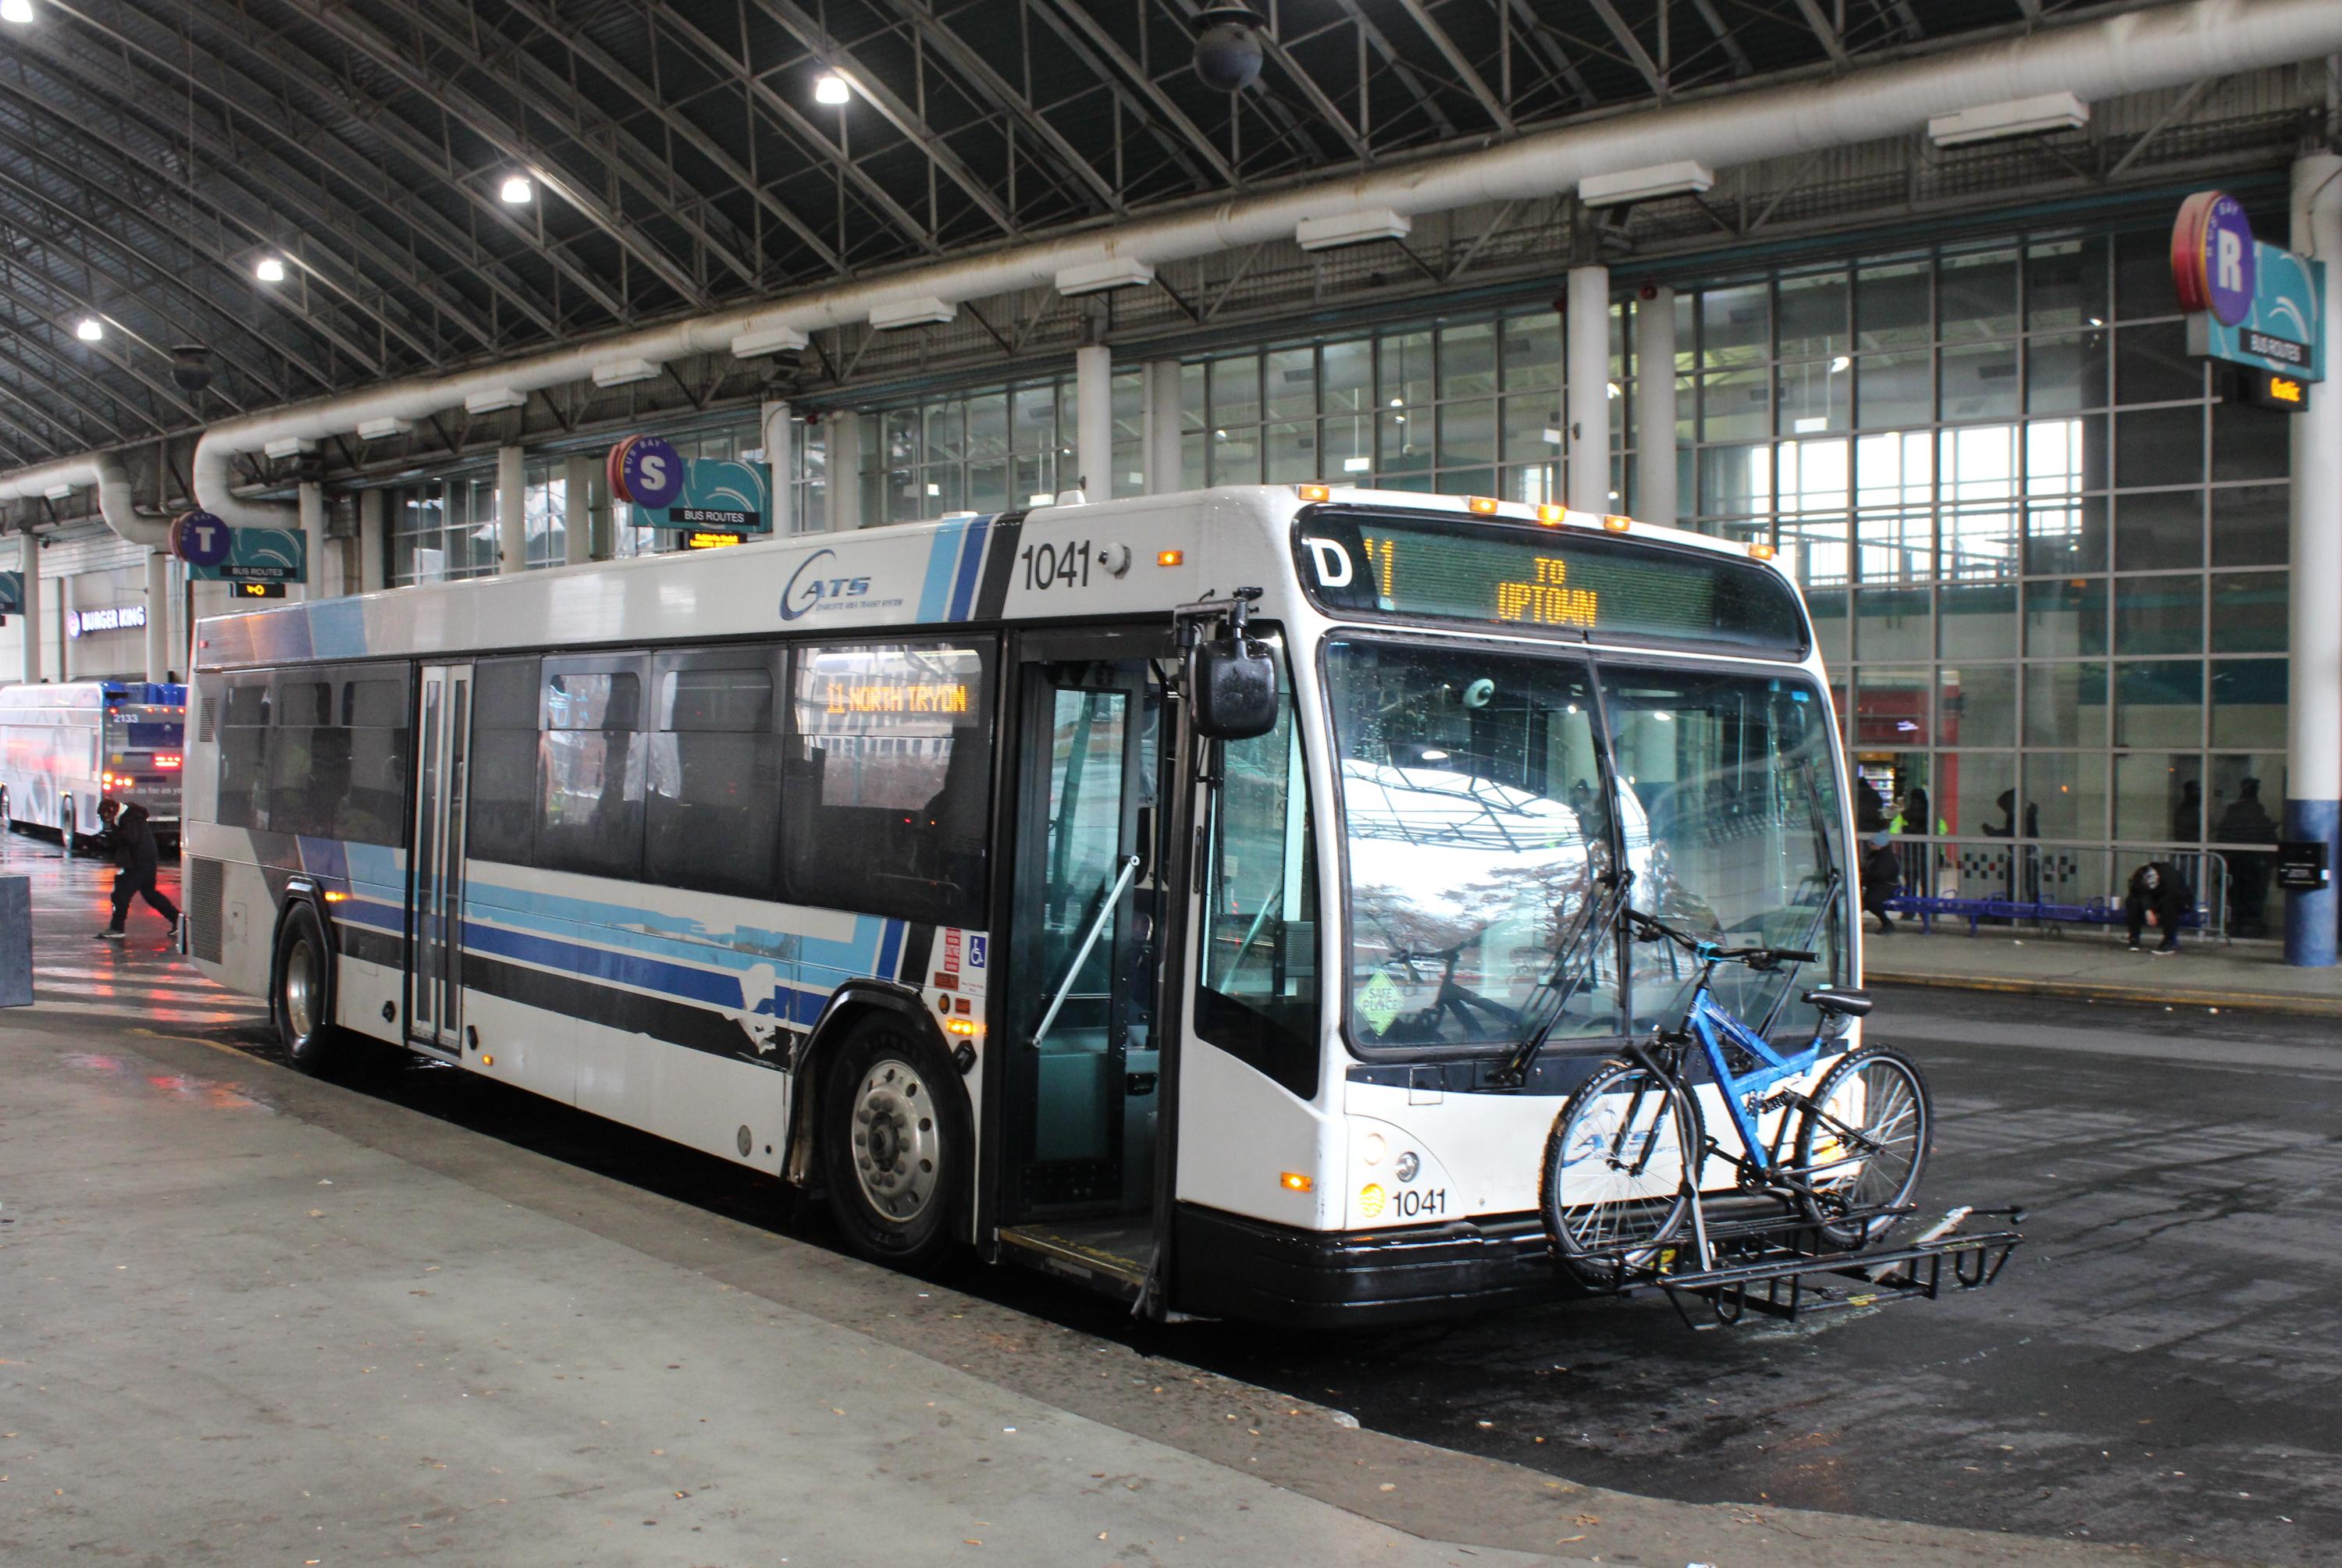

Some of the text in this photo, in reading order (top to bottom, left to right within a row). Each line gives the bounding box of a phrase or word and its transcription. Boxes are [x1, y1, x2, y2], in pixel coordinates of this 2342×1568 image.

[2218, 228, 2242, 293] R
[640, 455, 667, 491] S
[684, 510, 745, 523] BUS ROUTES
[195, 526, 215, 553] T
[232, 567, 284, 577] BUS ROUTES
[1021, 539, 1091, 591] 1041
[1308, 537, 1354, 588] D
[1534, 556, 1566, 585] TO
[779, 549, 871, 621] CATS
[81, 606, 145, 631] BURGER KING
[1498, 582, 1598, 628] UPTOWN
[826, 683, 966, 713] 11 NORTH TRYON
[113, 713, 138, 724] 2133
[1363, 988, 1399, 1012] SAFE PLACE
[1393, 1188, 1445, 1218] 1041
